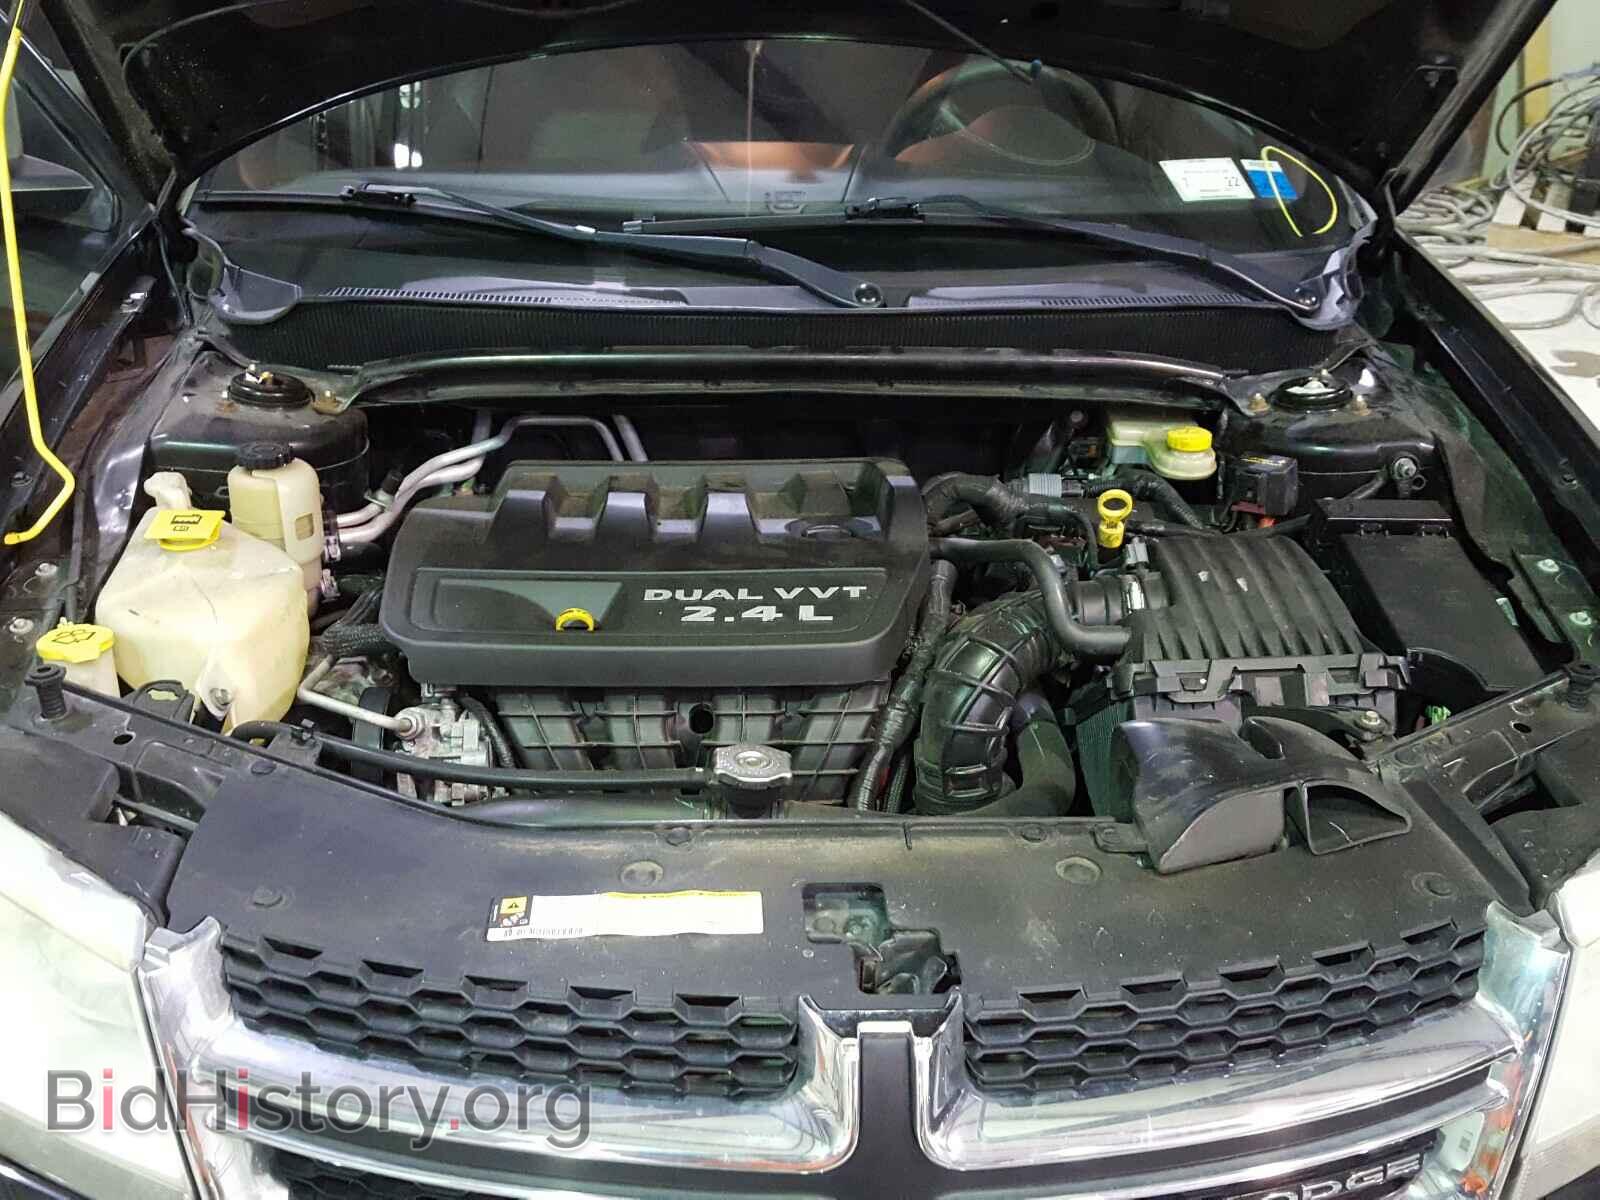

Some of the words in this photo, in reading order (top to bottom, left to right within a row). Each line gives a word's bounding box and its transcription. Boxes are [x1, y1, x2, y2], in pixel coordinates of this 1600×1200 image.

[643, 588, 763, 601] DUAL
[774, 586, 868, 599] VVT
[680, 605, 783, 622] 2.4
[798, 605, 834, 621] L
